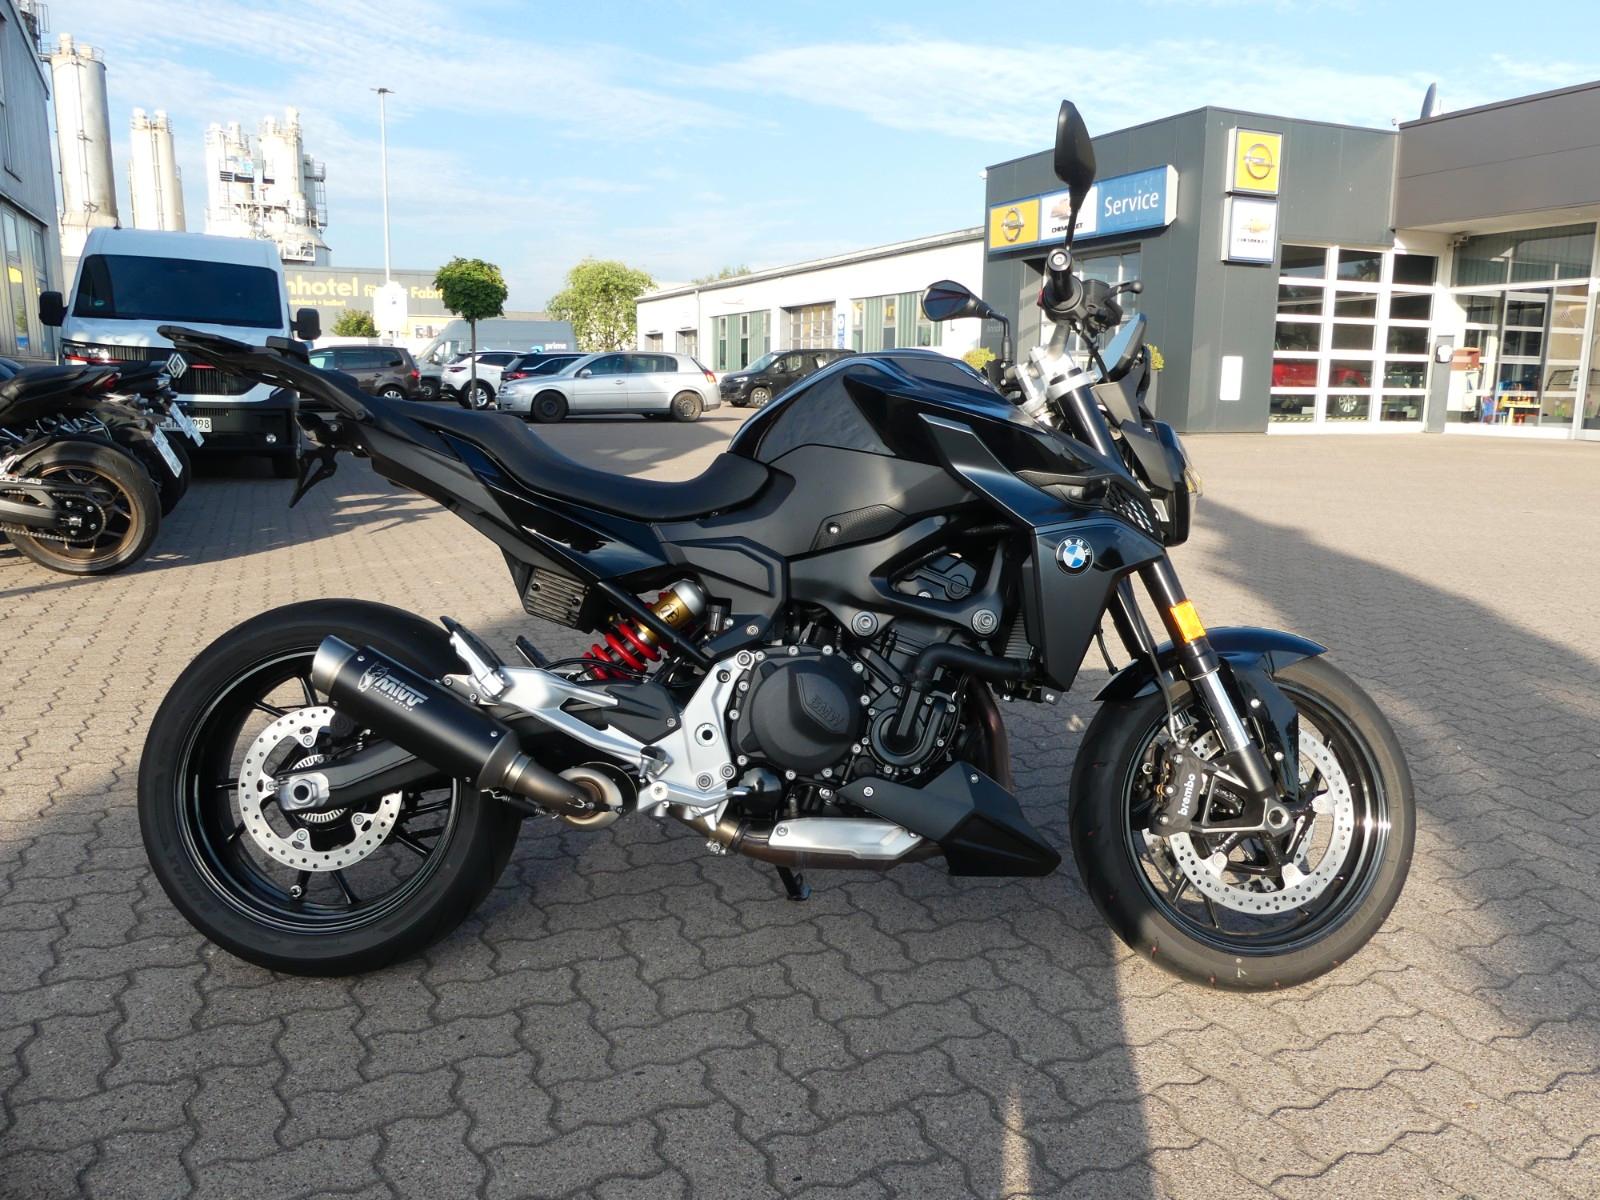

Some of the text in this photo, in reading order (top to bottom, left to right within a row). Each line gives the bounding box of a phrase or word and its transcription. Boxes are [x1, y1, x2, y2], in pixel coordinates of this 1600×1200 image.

[1104, 190, 1159, 217] Service
[544, 342, 567, 350] prime
[1177, 773, 1196, 816] brembo
